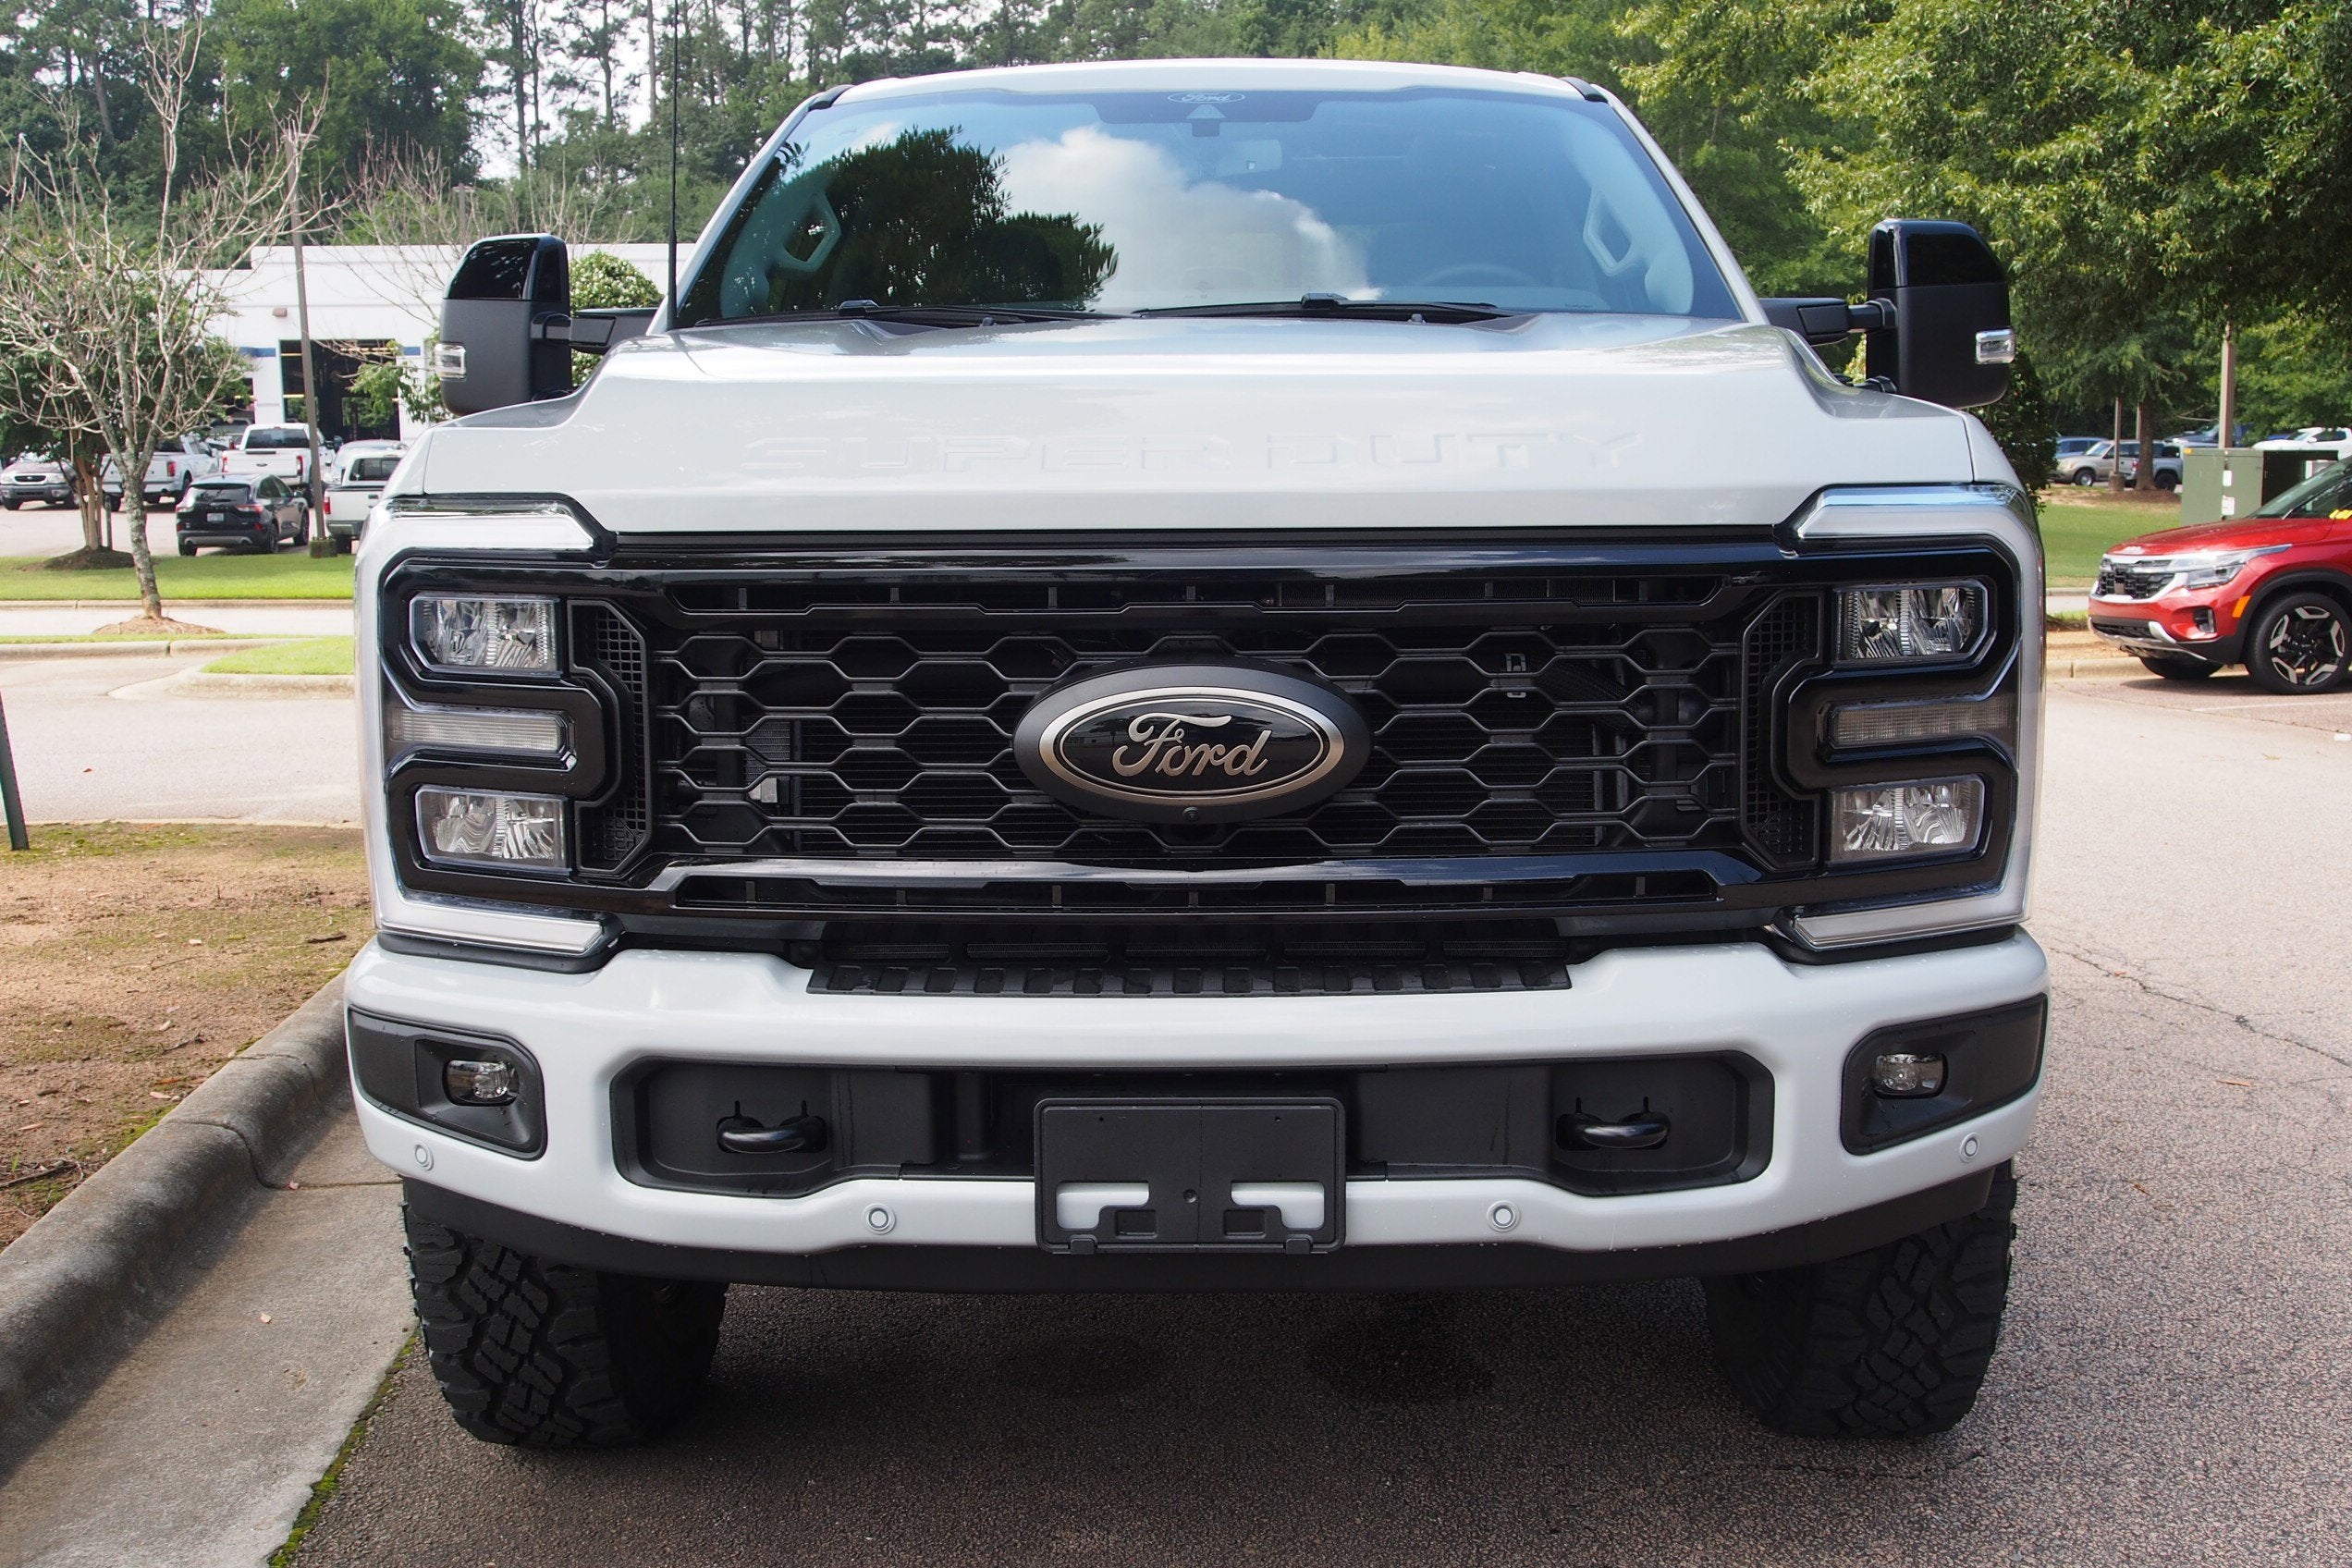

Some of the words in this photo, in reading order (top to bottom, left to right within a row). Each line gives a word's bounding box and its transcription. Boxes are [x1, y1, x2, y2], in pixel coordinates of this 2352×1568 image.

[1182, 92, 1231, 102] Ford
[739, 434, 1235, 472] SUPER
[1264, 431, 1644, 471] DUTY
[1112, 712, 1272, 777] Ford
